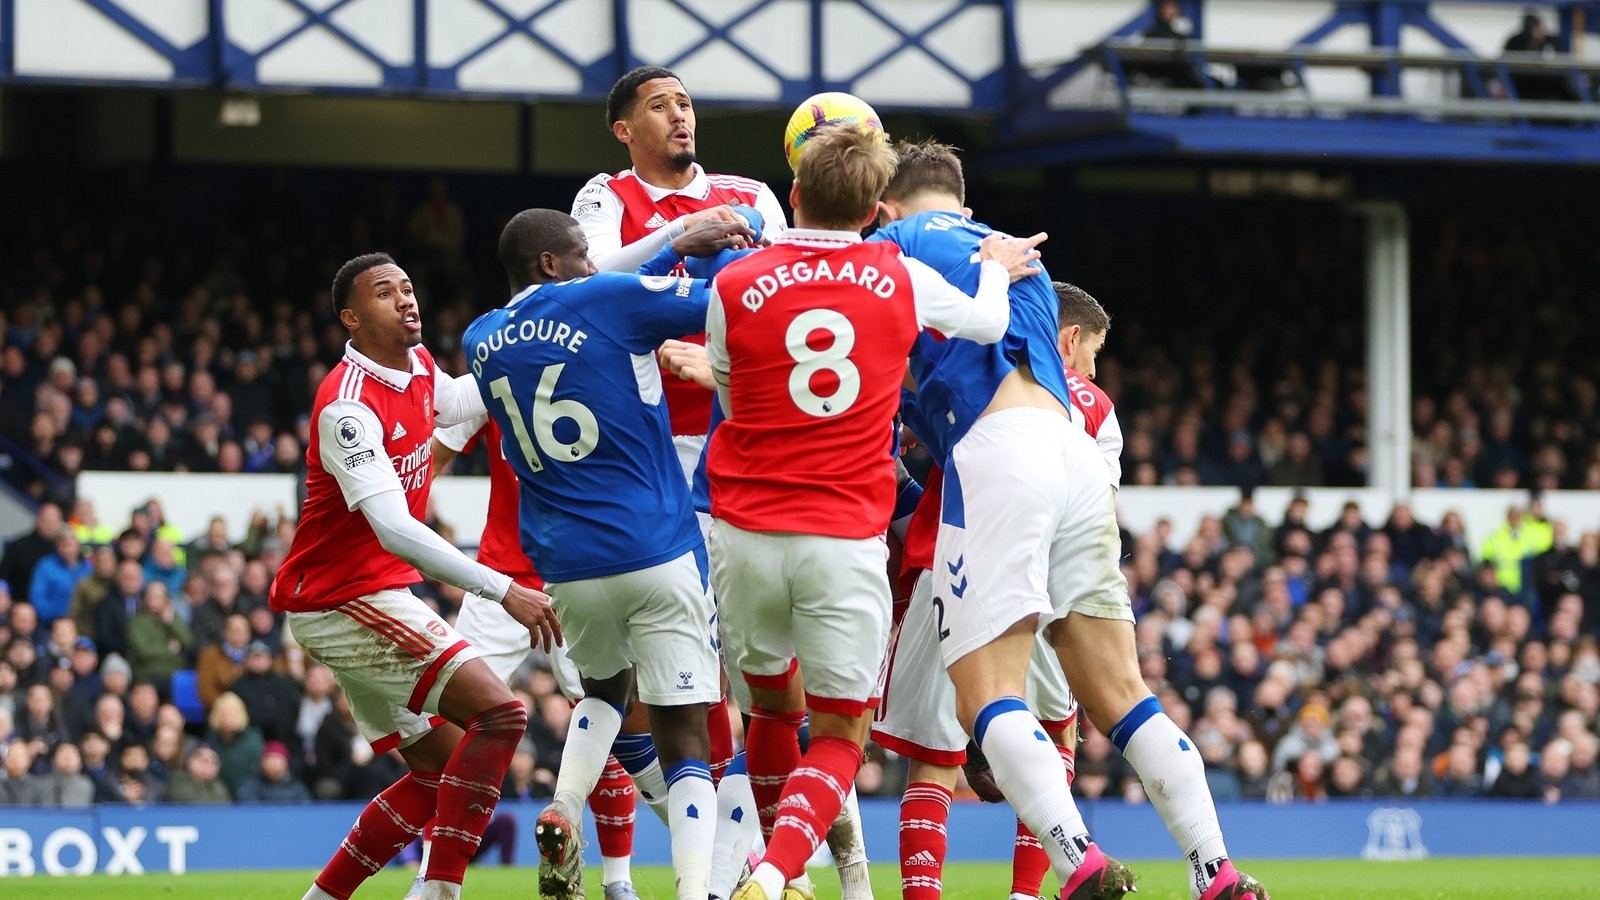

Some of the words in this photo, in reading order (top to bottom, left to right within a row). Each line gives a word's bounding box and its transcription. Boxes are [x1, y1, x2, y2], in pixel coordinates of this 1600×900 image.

[741, 259, 896, 313] ØDEGAARD
[472, 319, 588, 380] DOUCOURE
[785, 308, 861, 418] 8
[1065, 370, 1096, 408] HO
[489, 362, 600, 474] 16
[932, 596, 951, 642] 2
[599, 784, 634, 798] AFC
[0, 826, 200, 876] BOXT
[904, 856, 940, 869] adidas
